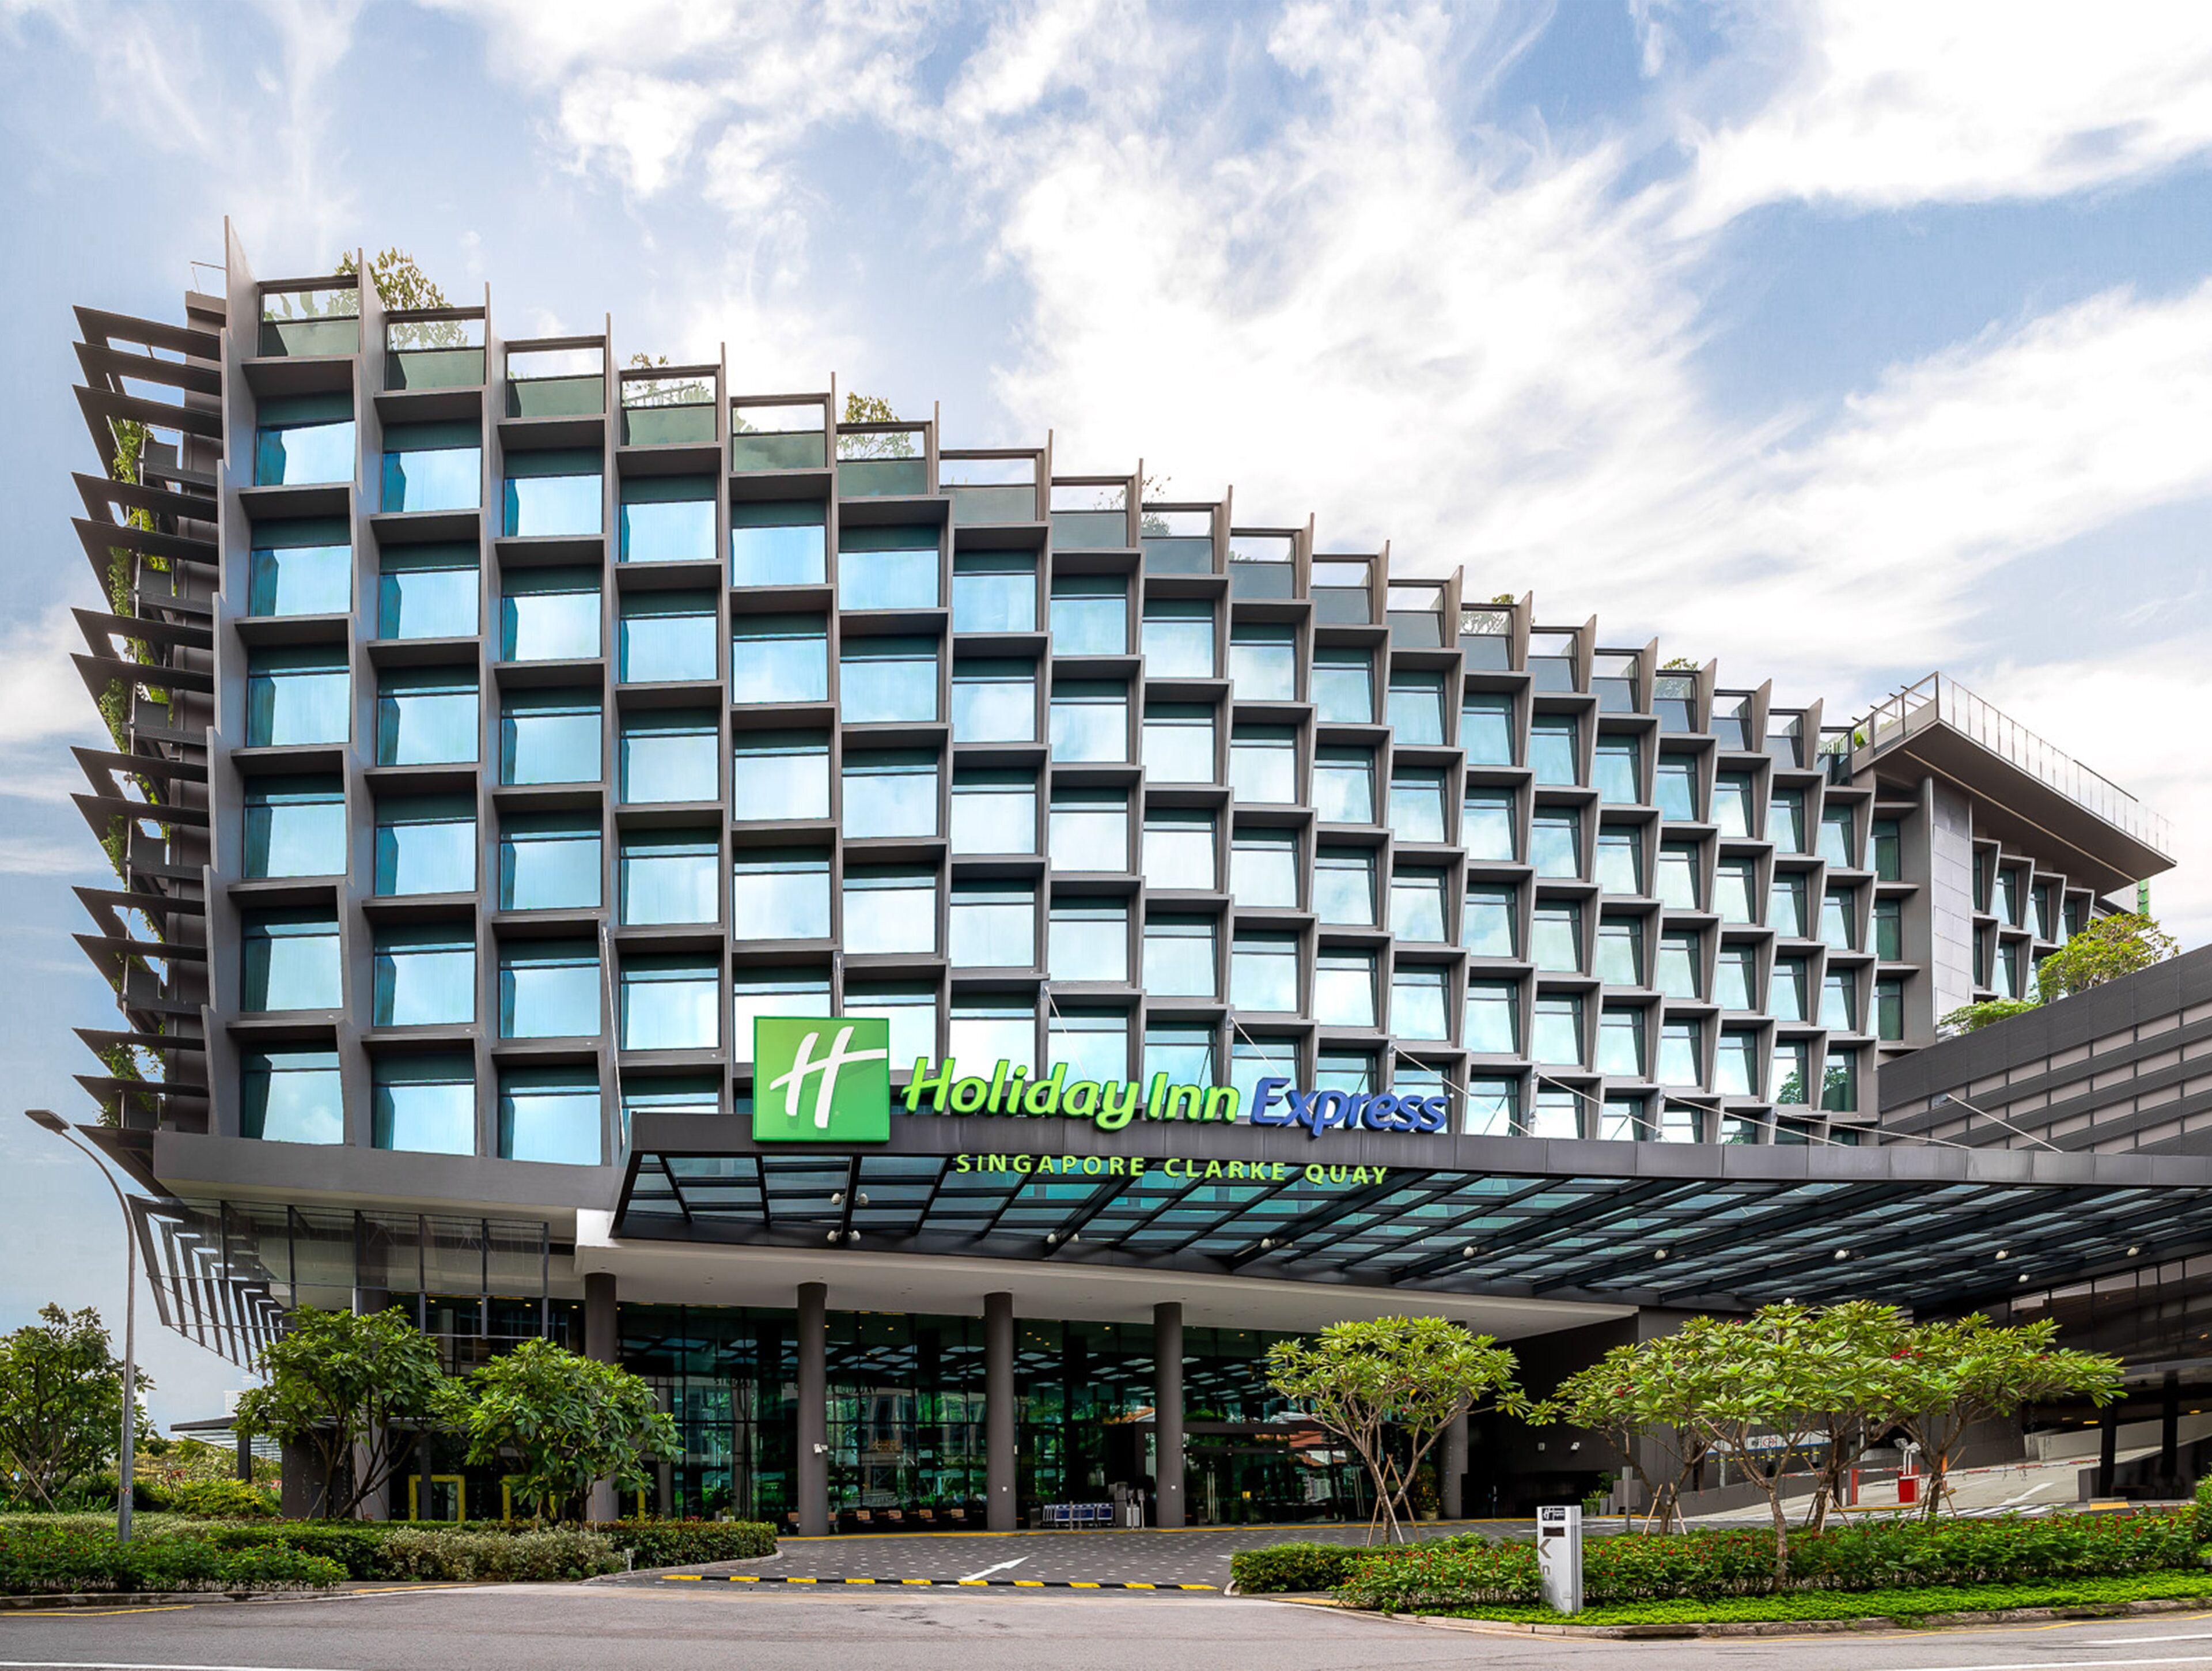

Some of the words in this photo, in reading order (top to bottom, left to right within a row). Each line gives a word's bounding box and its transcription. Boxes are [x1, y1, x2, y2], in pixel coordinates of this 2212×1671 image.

[902, 1057, 1139, 1132] Holiday
[1146, 1072, 1240, 1123] Inn
[1250, 1077, 1448, 1137] Express
[956, 1154, 1145, 1177] SINGAPORE
[1164, 1158, 1286, 1182] CLARKE
[1304, 1163, 1387, 1185] QUAY
